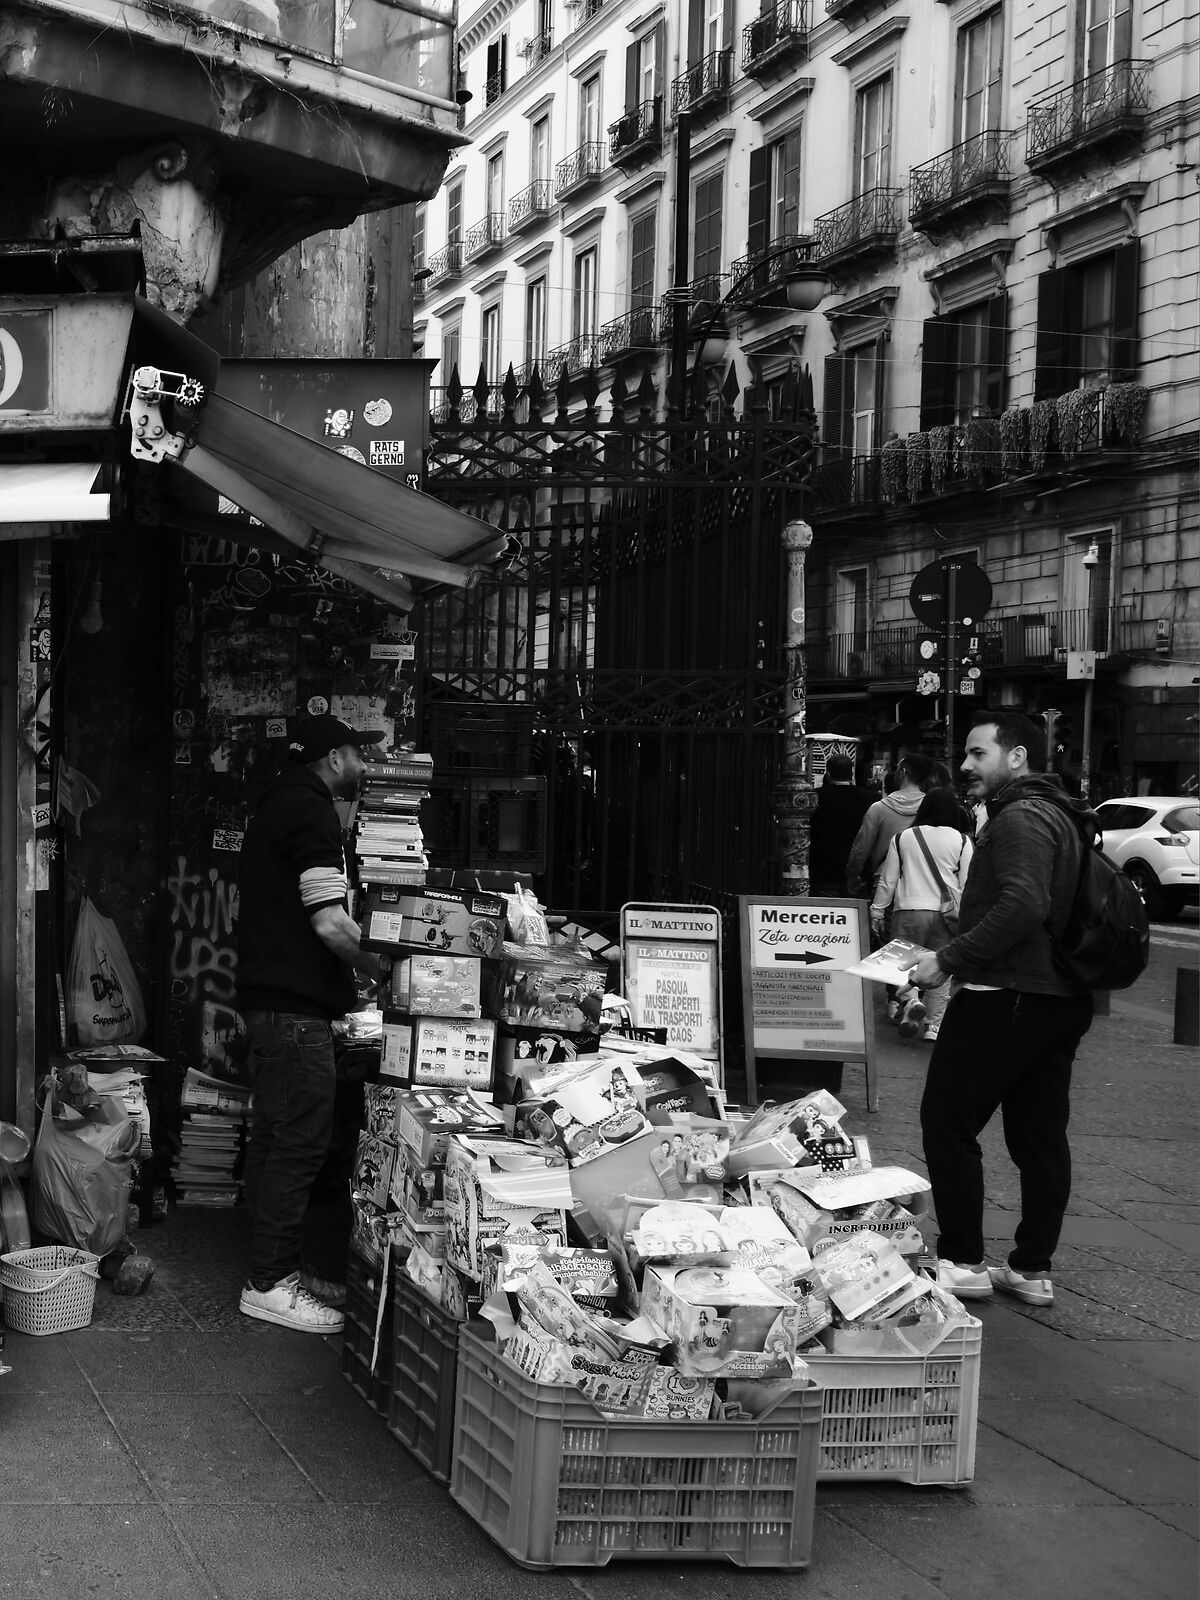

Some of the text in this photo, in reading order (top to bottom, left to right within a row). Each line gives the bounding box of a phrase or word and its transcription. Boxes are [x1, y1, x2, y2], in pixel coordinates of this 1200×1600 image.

[374, 441, 399, 453] RATS
[760, 909, 847, 926] Merceria
[629, 919, 714, 932] IL MATTINO
[758, 929, 851, 947] Zeta creazioni
[638, 948, 708, 960] IL MATTINO
[656, 979, 689, 995] PASQUA
[645, 994, 701, 1011] MUSEI APERTI
[643, 1010, 703, 1027] MA TRASPORTI
[670, 1028, 693, 1043] CAOS
[671, 1377, 680, 1389] I
[666, 1394, 696, 1404] BUNNIES
